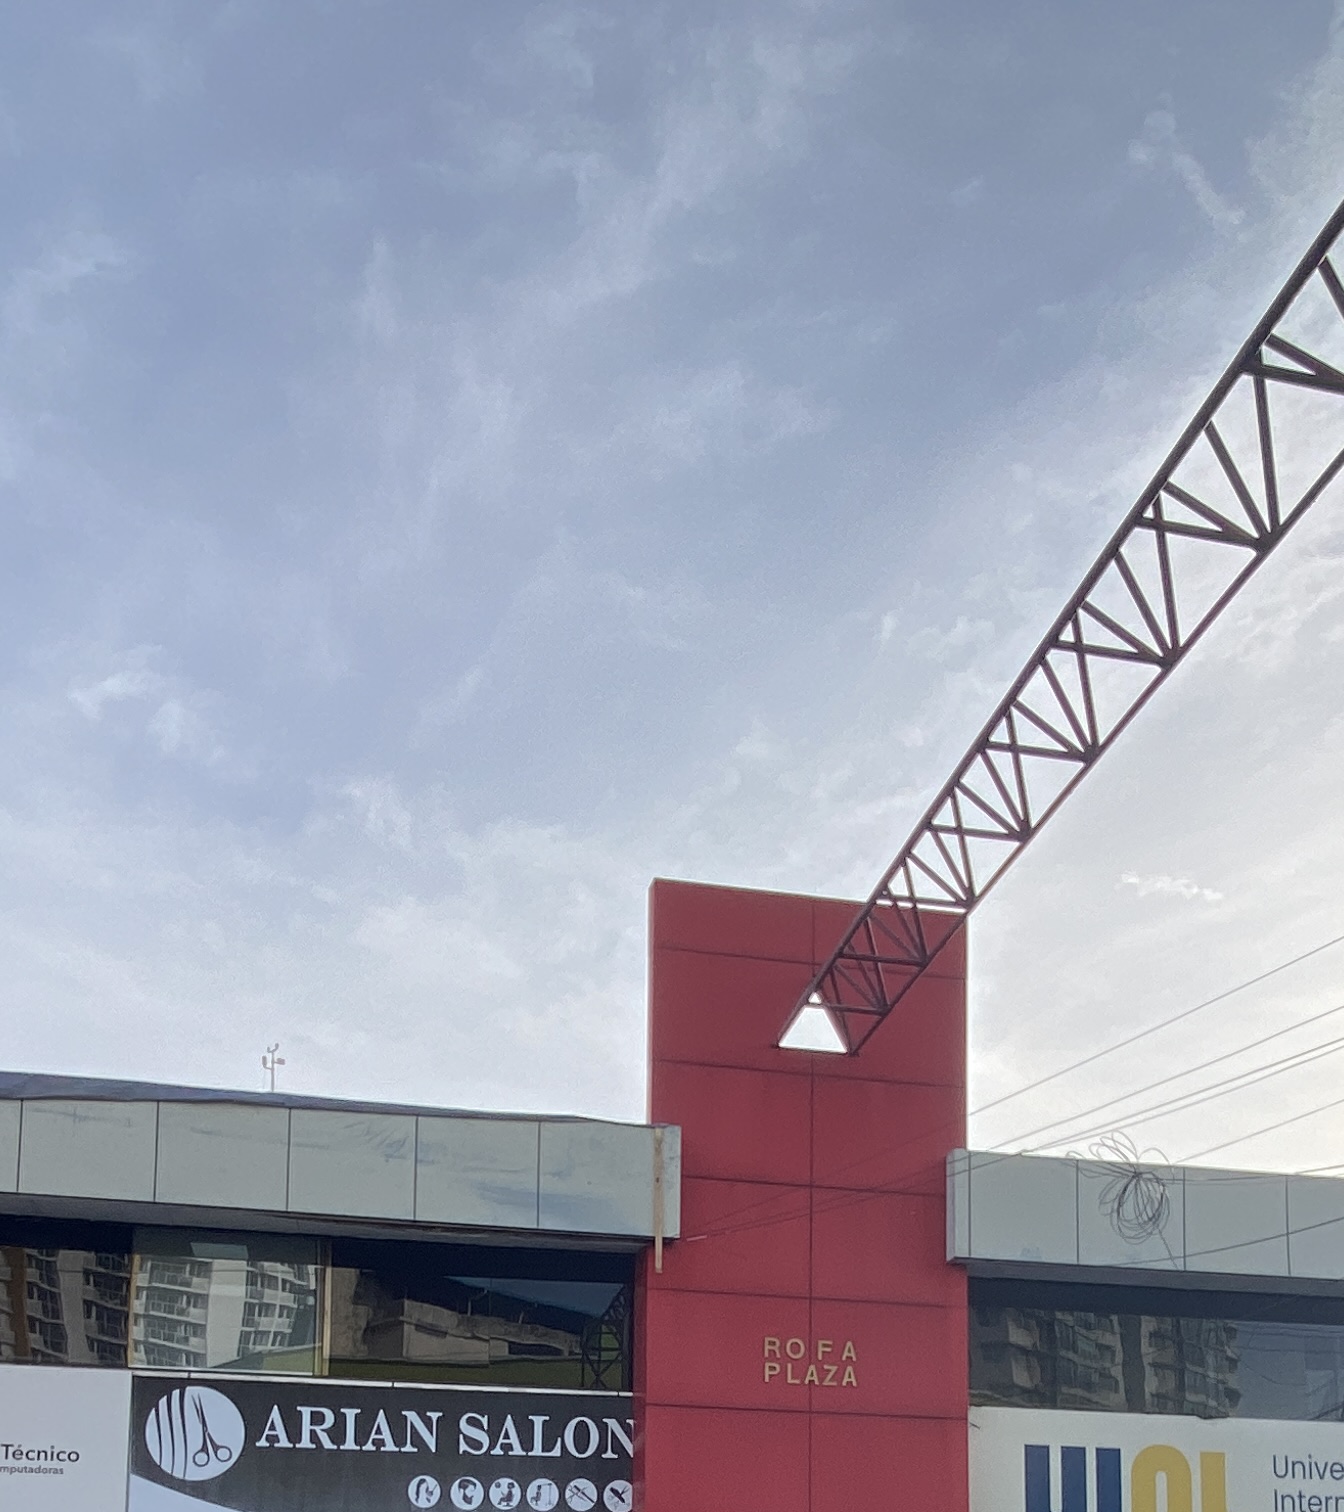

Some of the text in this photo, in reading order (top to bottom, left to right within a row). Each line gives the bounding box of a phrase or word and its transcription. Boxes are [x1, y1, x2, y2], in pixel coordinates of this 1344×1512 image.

[764, 1362, 857, 1388] PLAZA
[255, 1403, 635, 1459] ARIAN SALON
[0, 1443, 80, 1463] Técnico
